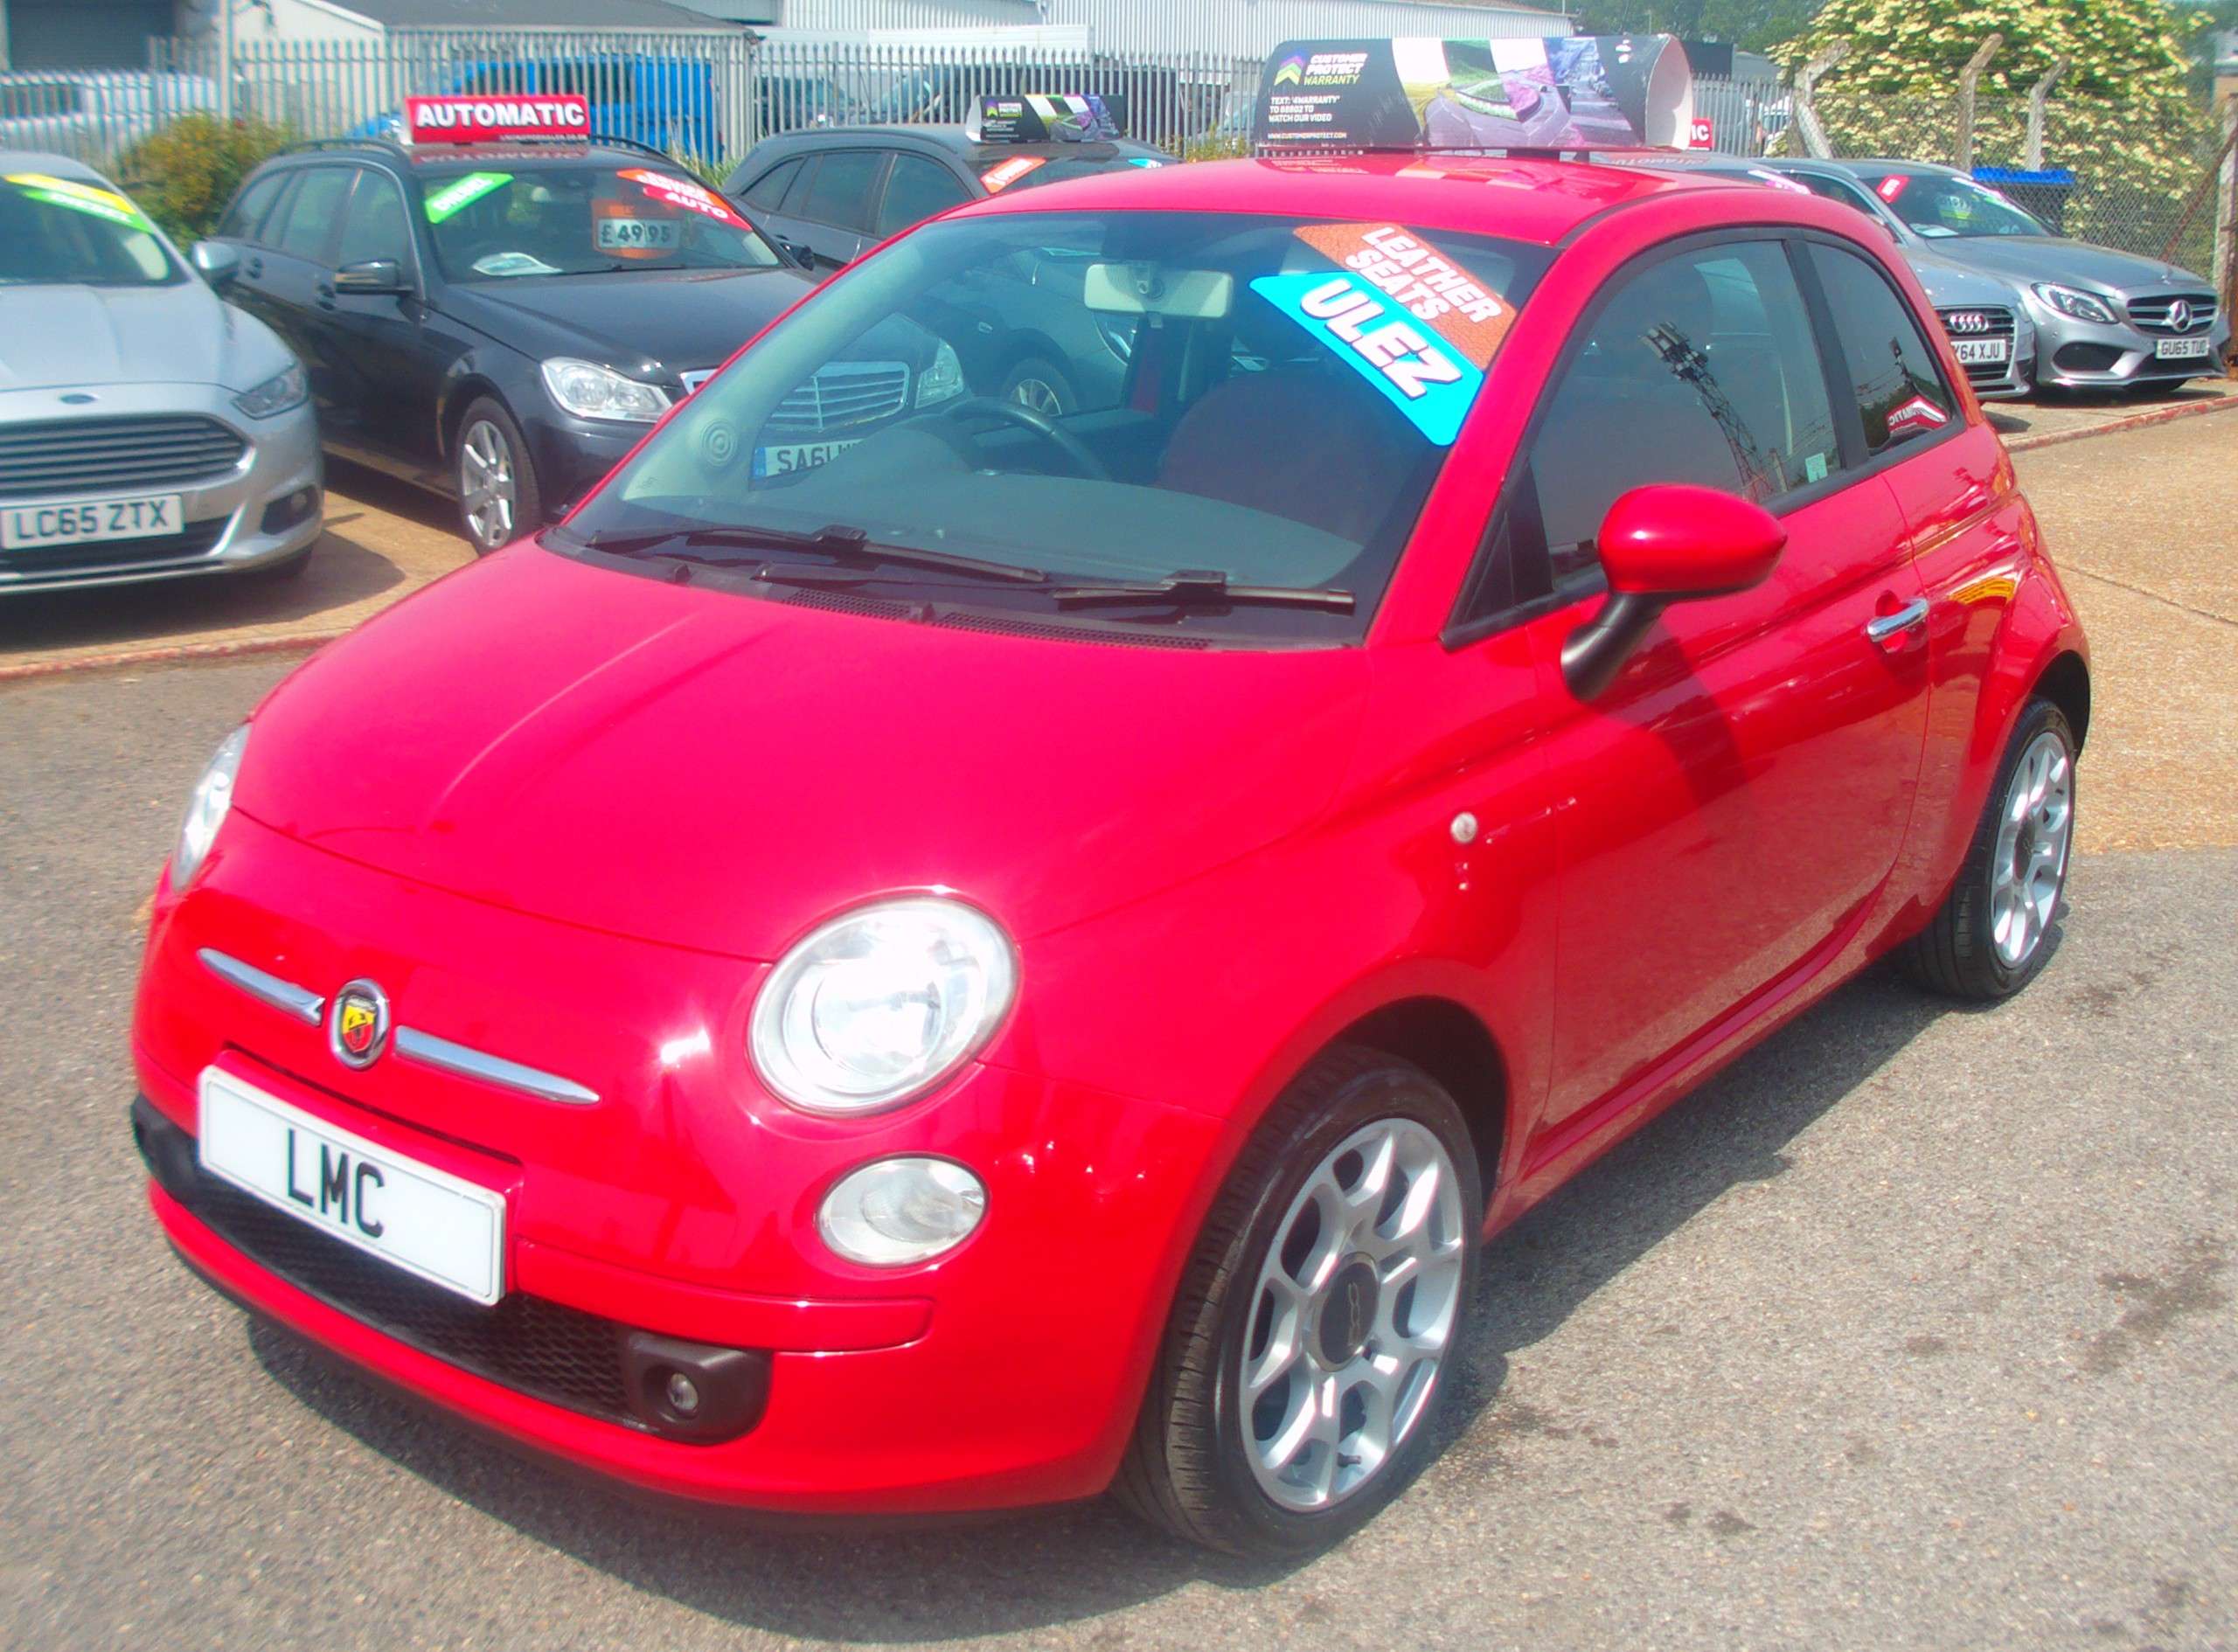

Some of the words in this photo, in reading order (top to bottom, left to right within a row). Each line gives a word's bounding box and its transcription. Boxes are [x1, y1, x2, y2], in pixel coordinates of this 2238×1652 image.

[1303, 74, 1360, 86] WARRANTY
[1305, 63, 1364, 75] PROTECT
[1269, 105, 1279, 114] TO
[1271, 96, 1291, 105] TEXT:
[417, 102, 587, 128] AUTOMATIC
[1294, 114, 1309, 122] OUR
[1310, 113, 1332, 121] VIDEO
[664, 191, 728, 219] AUTO
[1345, 249, 1451, 321] SEATS
[1361, 226, 1503, 323] LEATHER
[1300, 278, 1463, 401] ULEZ
[1978, 342, 2000, 359] XJU
[14, 506, 99, 540] LC65
[107, 499, 168, 532] ZTX
[287, 1128, 385, 1239] LMC
